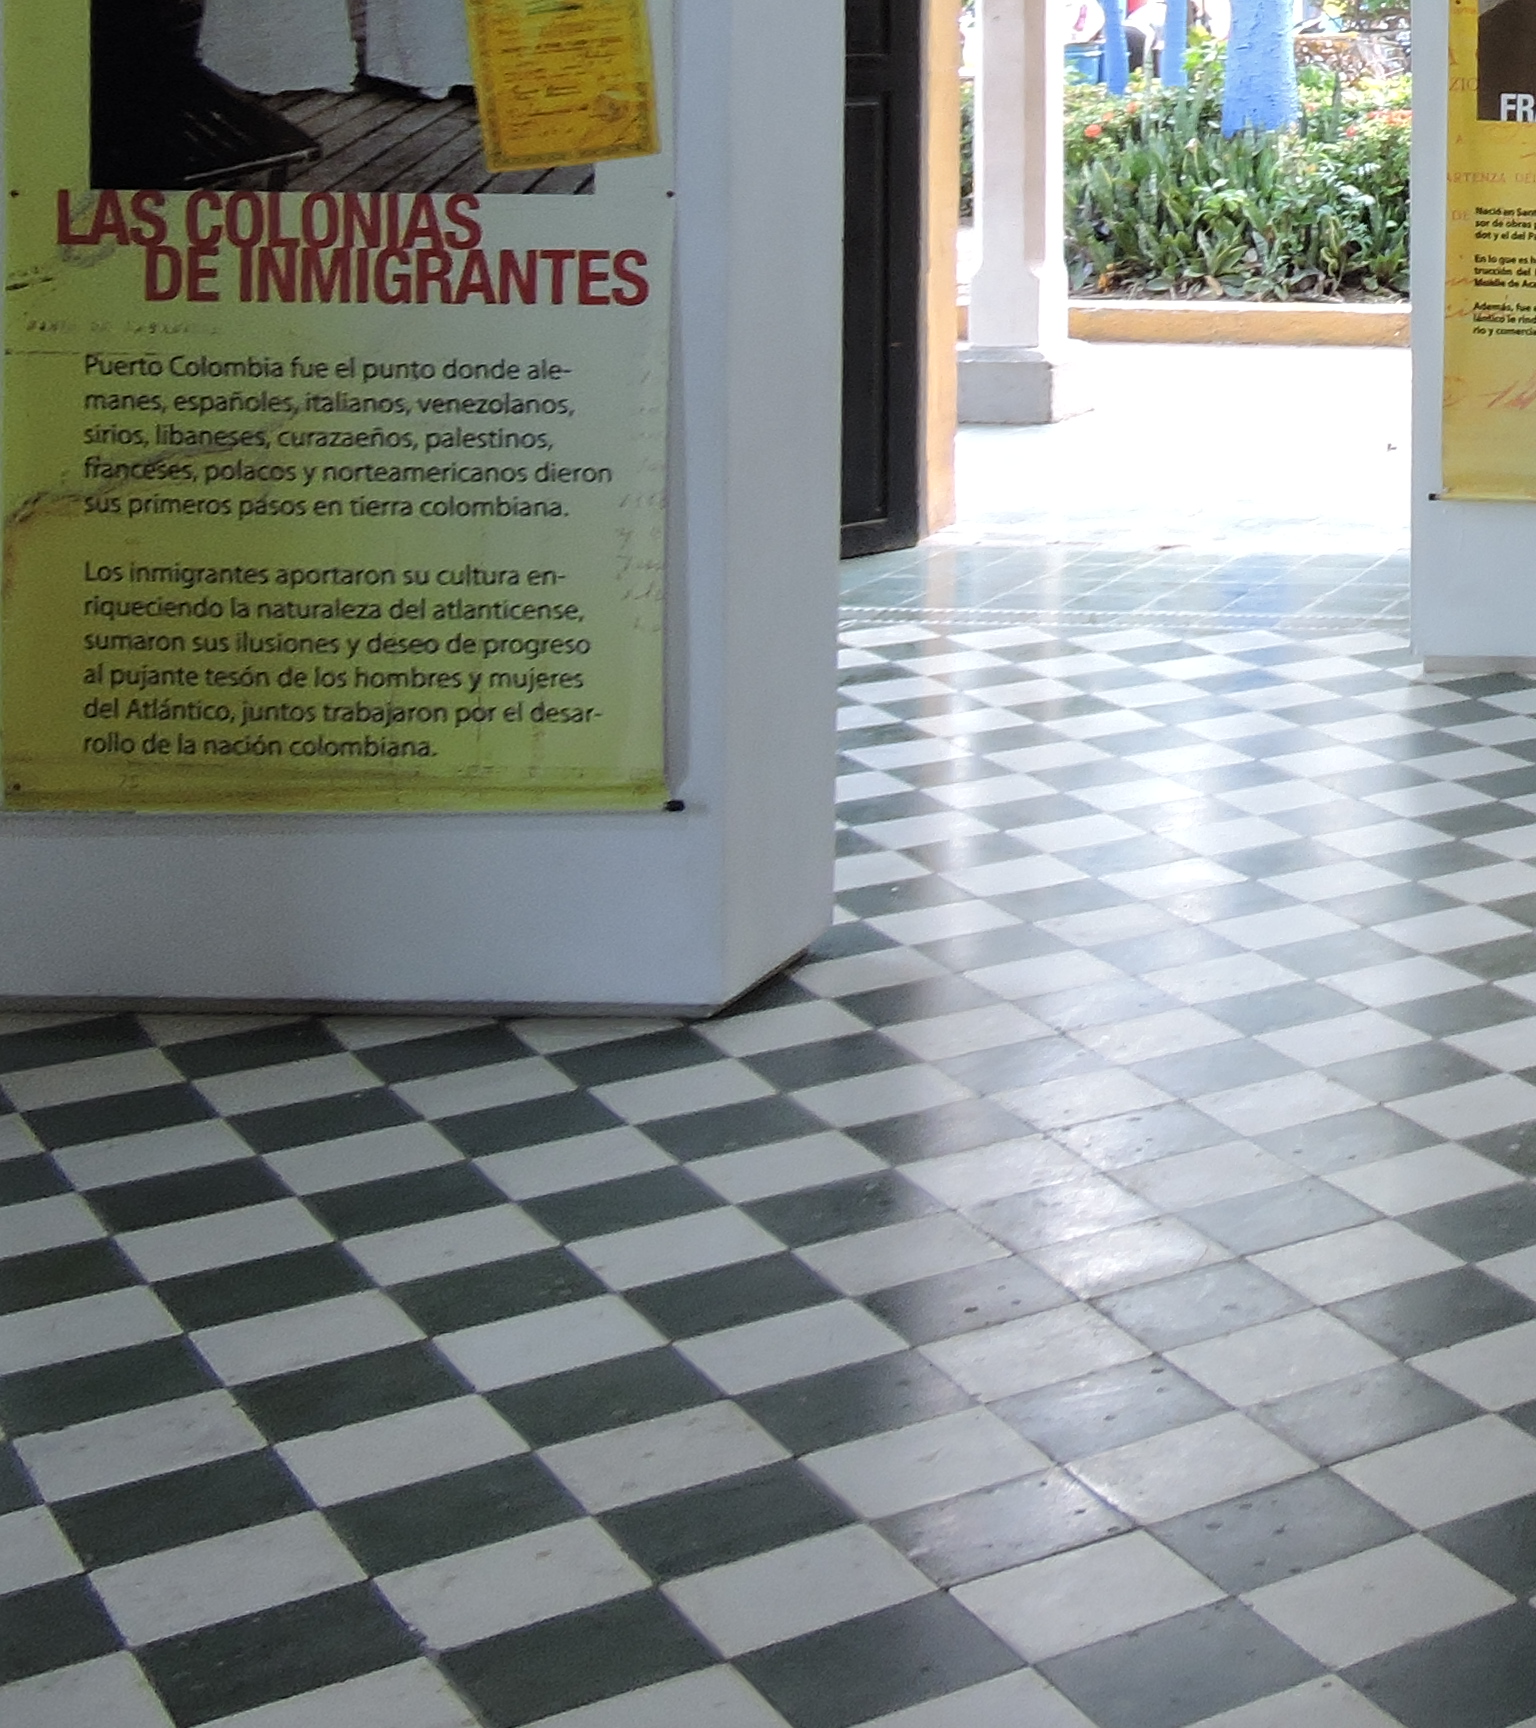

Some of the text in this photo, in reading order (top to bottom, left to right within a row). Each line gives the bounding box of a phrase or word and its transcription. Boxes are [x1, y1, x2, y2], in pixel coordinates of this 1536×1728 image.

[56, 188, 483, 251] LAS COLONIAS
[144, 244, 650, 307] DE INMIGRANTES
[84, 354, 571, 385] Puerto Colombia fue el punto donde ale-
[84, 390, 574, 419] manes, españoles, italianos, venezolanos,
[84, 423, 554, 454] sirios, libaneses, curazaeños, palestinos,
[204, 458, 296, 487] polacos
[302, 464, 317, 487] y
[322, 459, 528, 482] norteamericanos
[533, 460, 611, 483] dieron
[84, 492, 568, 521] sus primeros pasos en tierra colombiana.
